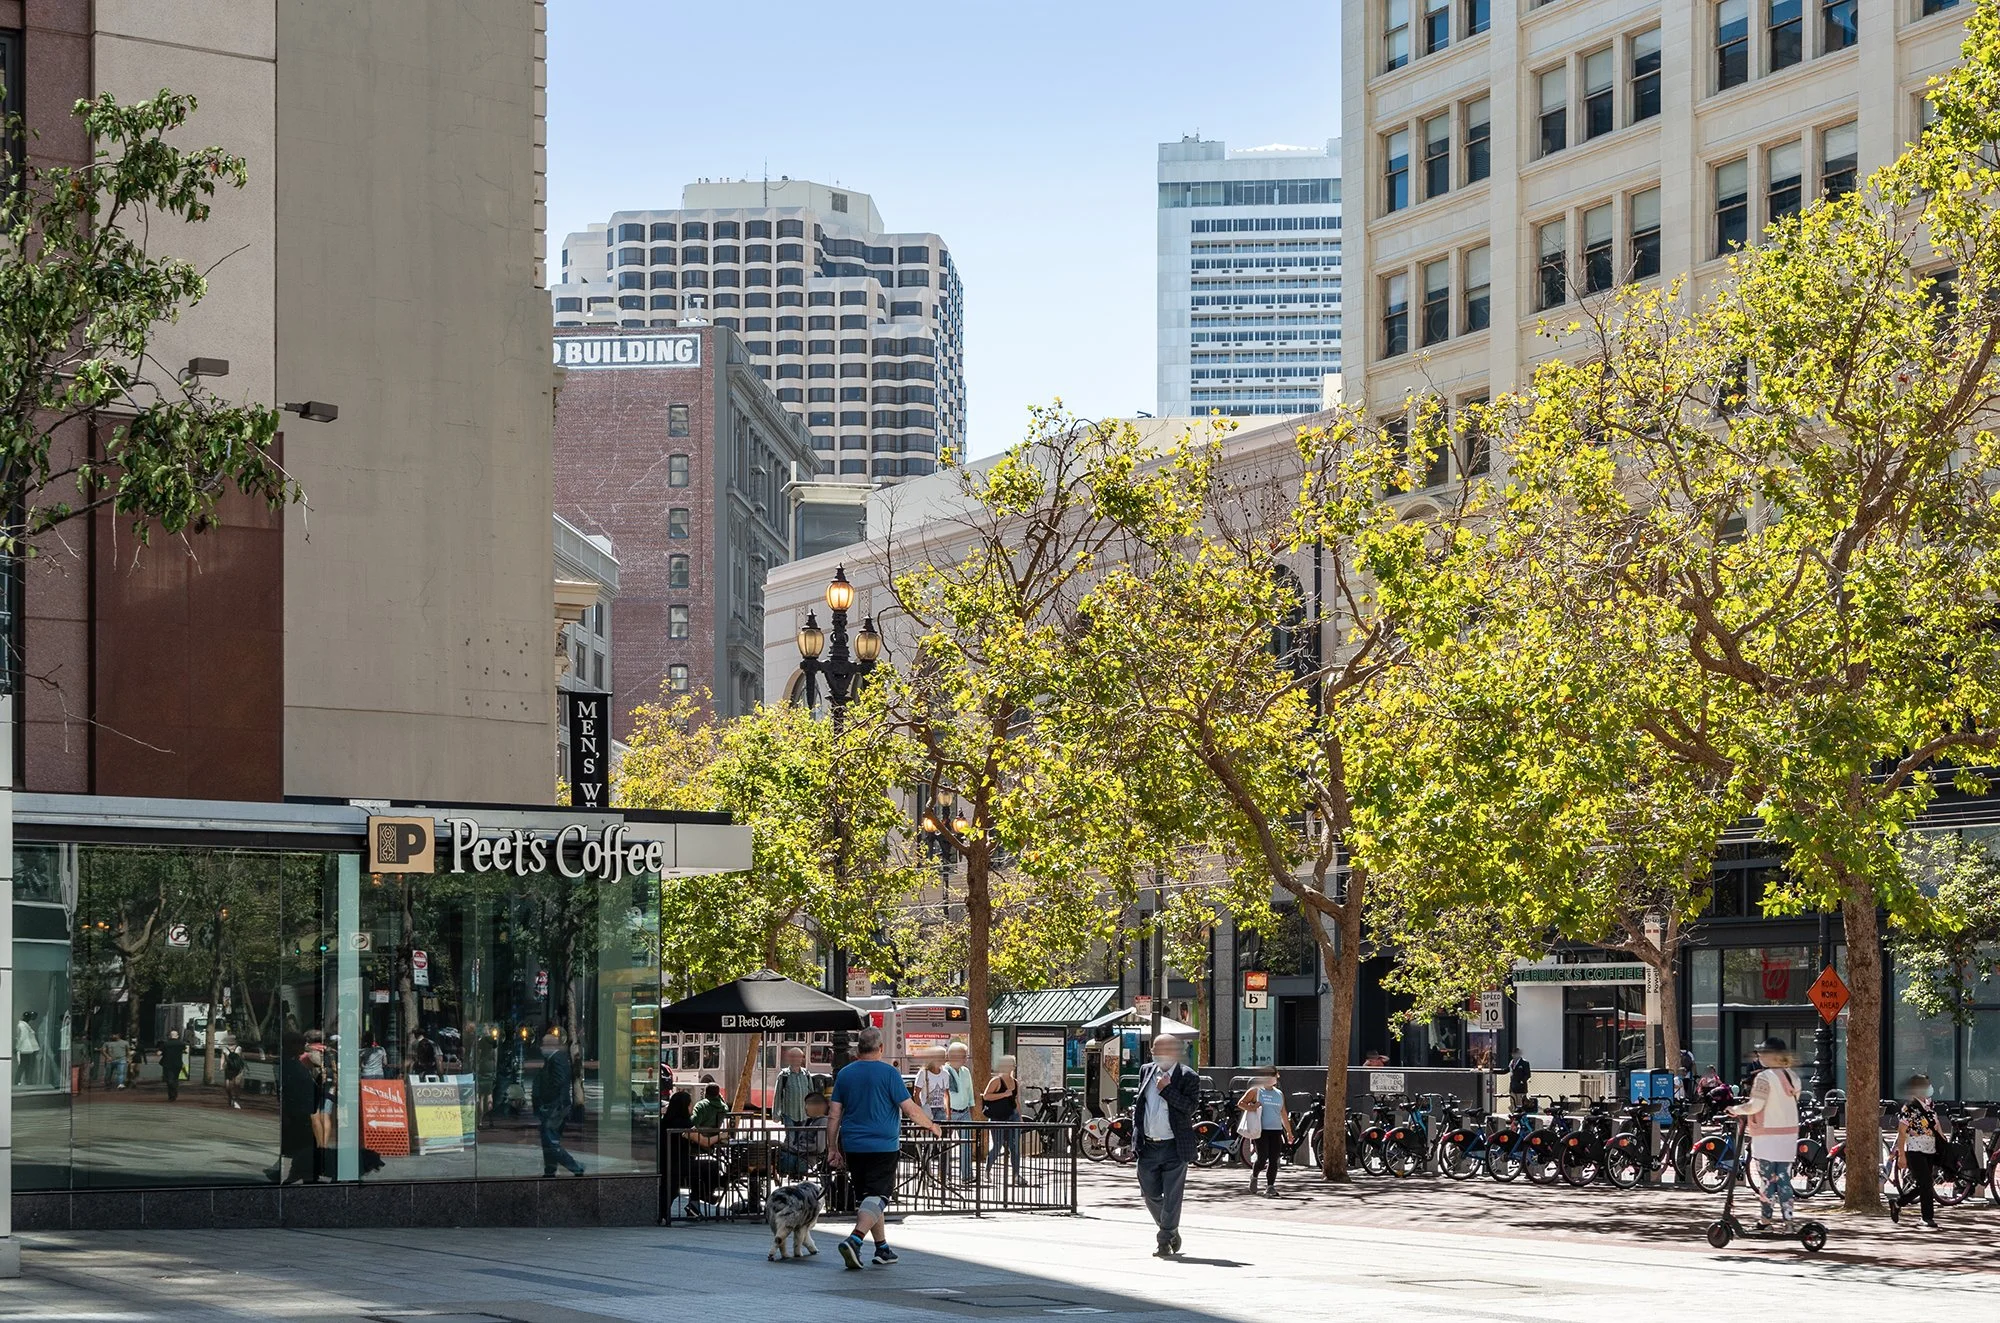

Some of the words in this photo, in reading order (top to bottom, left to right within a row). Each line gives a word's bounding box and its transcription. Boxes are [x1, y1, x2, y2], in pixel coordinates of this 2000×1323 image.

[565, 339, 693, 364] BUILDING
[443, 816, 548, 877] Peet's
[555, 822, 665, 884] Coffee
[1584, 966, 1644, 981] COFFEE
[760, 1014, 786, 1028] Coffee
[1486, 1009, 1498, 1022] 10
